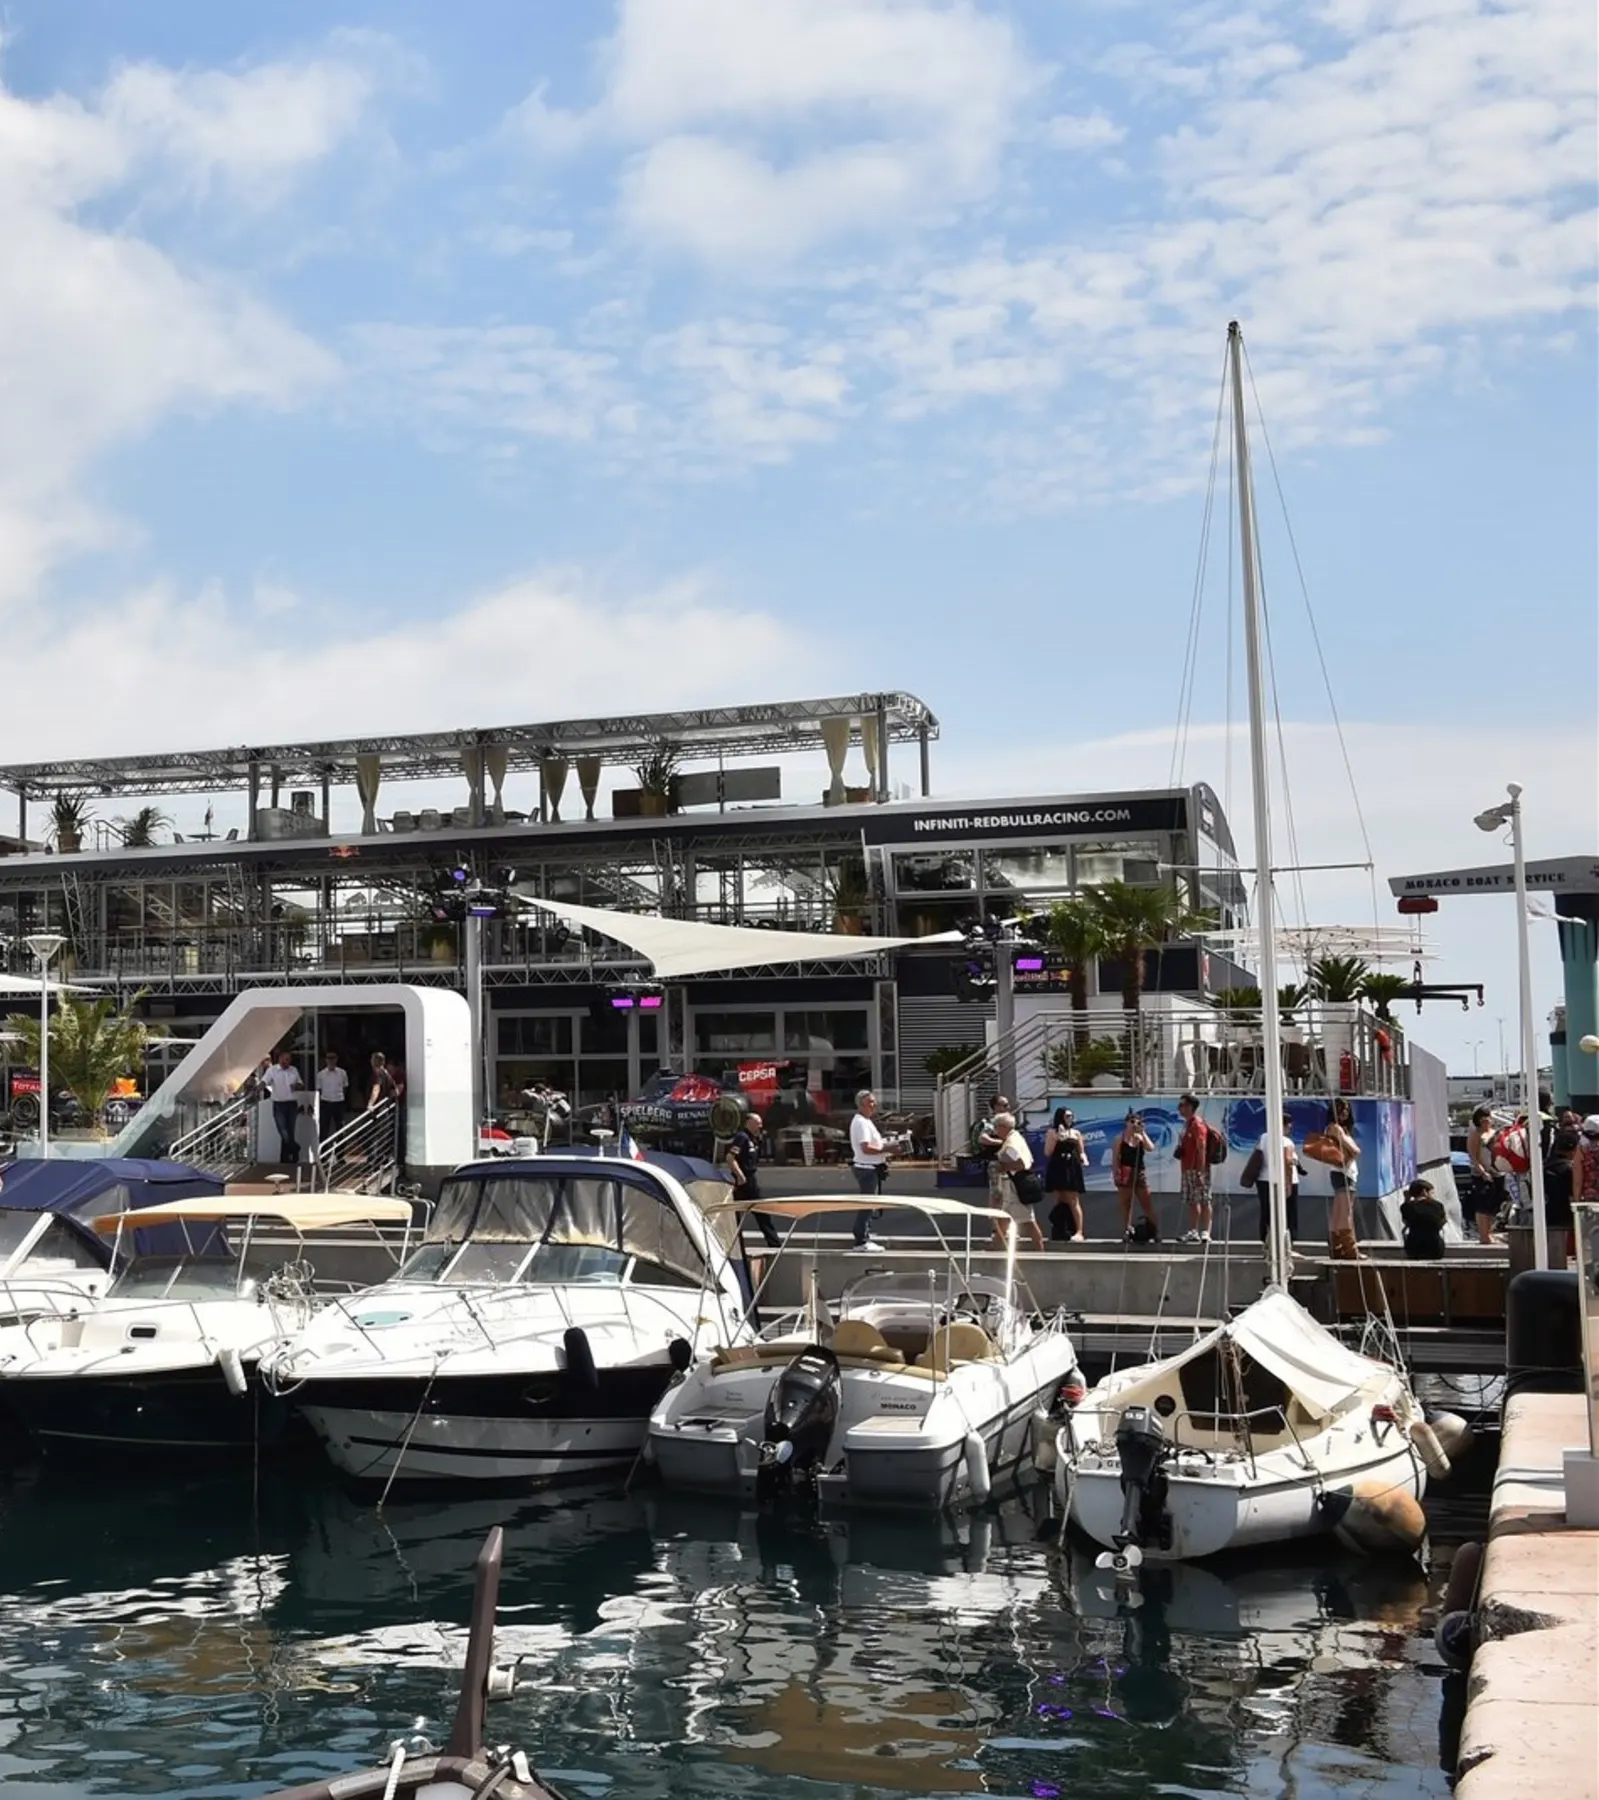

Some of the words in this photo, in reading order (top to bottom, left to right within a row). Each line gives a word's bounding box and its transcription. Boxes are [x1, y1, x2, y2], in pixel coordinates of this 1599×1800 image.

[914, 809, 1131, 832] INFINITI-REDBULLRACING.COM
[1405, 876, 1461, 890] MONACO
[1467, 874, 1499, 887] BOAT
[1507, 872, 1566, 886] SRVICE
[738, 1067, 777, 1082] CEPSA
[620, 1105, 673, 1120] SPIELBERG
[880, 1402, 917, 1411] MONACO
